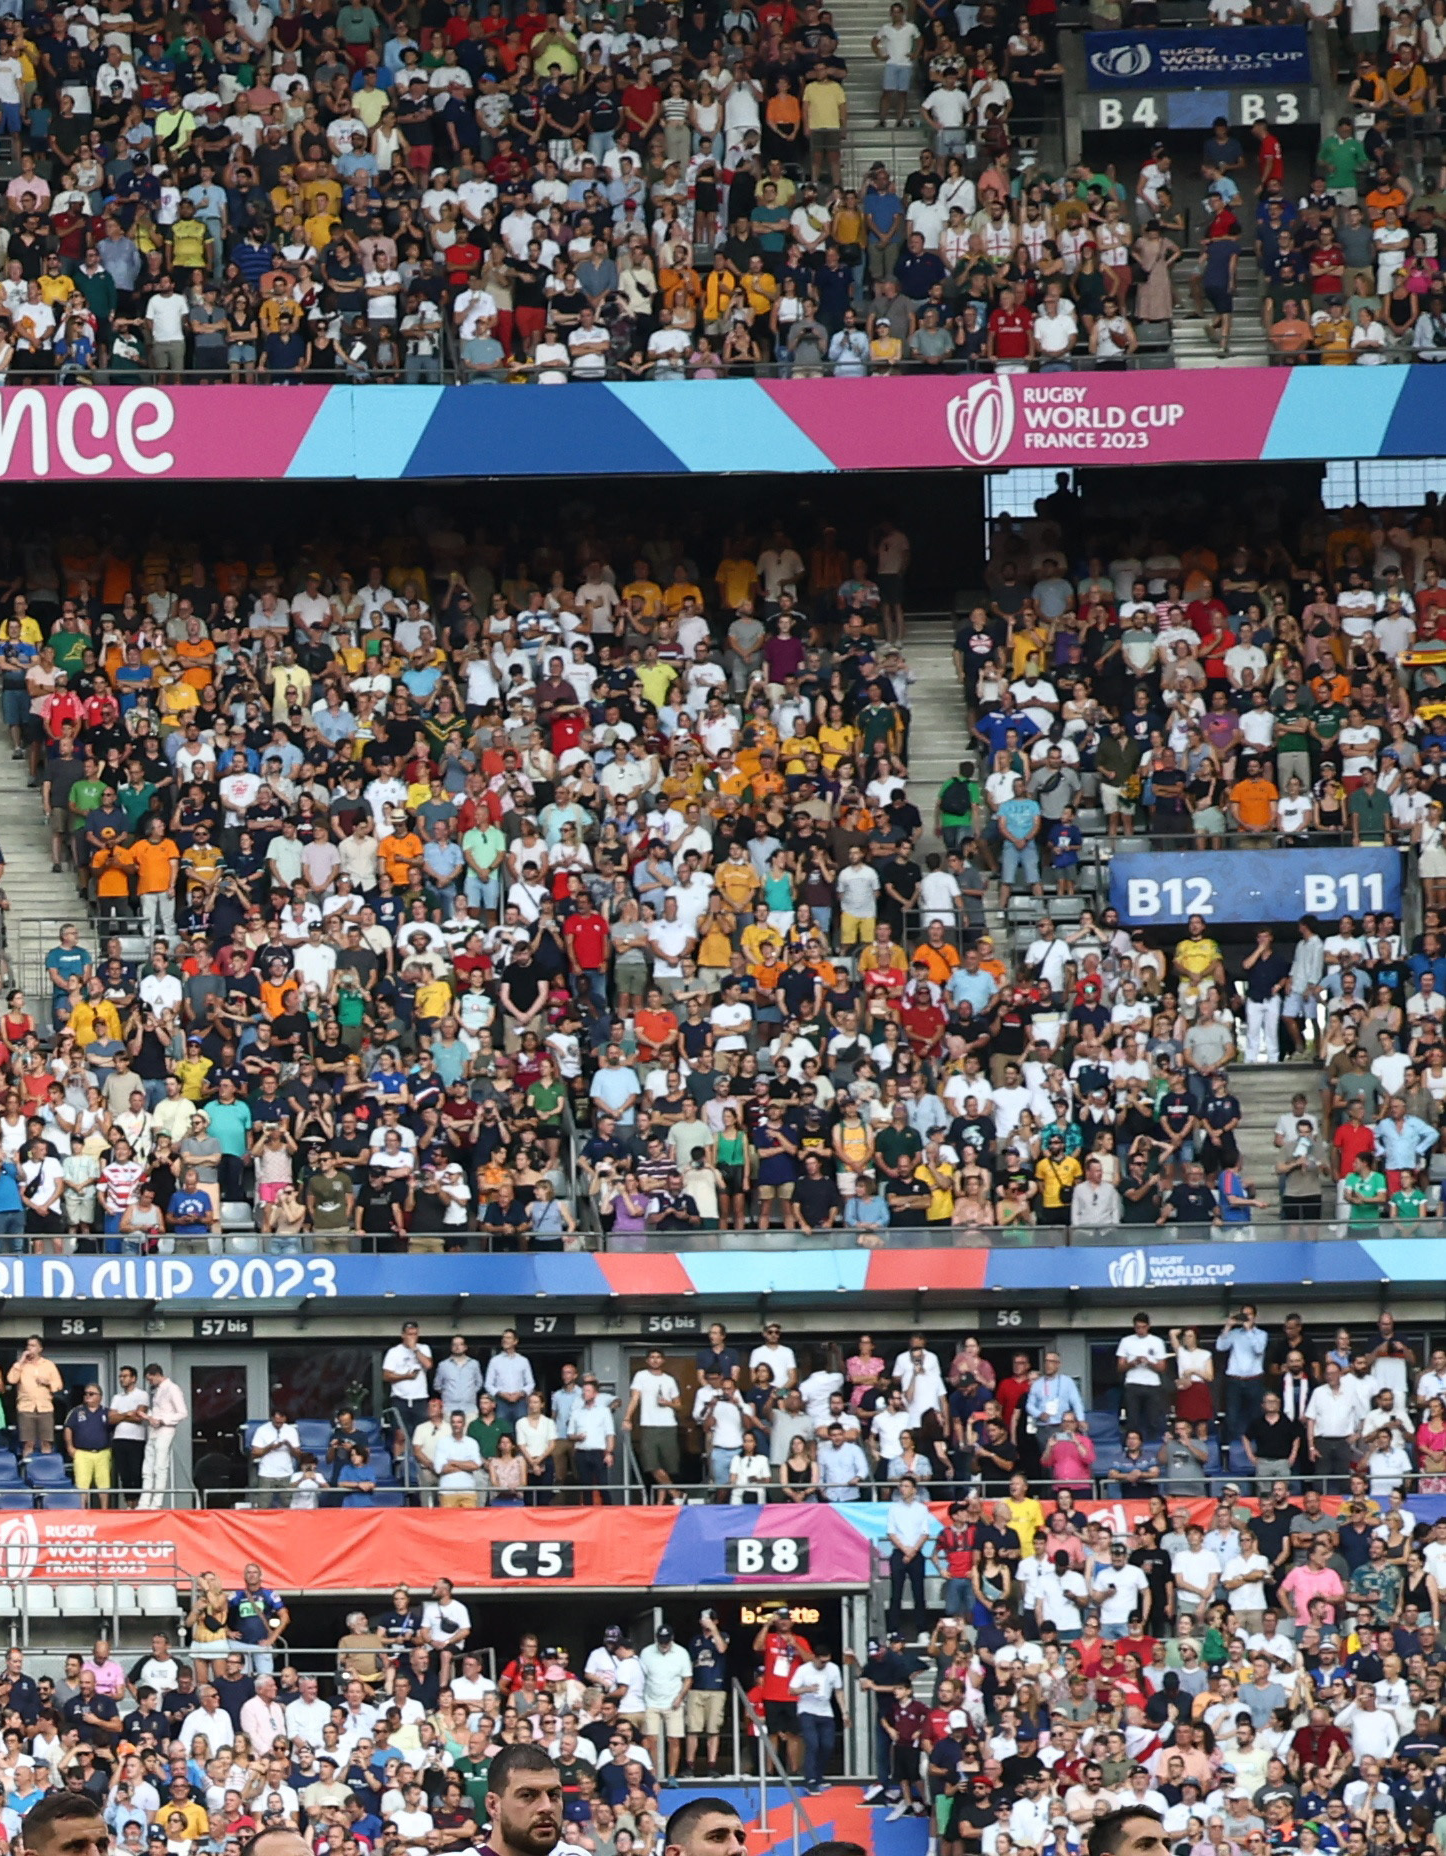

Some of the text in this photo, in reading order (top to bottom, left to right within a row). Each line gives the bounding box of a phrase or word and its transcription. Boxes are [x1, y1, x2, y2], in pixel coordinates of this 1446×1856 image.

[1160, 51, 1304, 66] WORLD CUP
[1160, 63, 1226, 73] FRANCE
[1023, 386, 1088, 406] RUGBY
[1023, 402, 1185, 430] WORLD CUP
[1023, 429, 1150, 451] FRANCE 2023
[1127, 877, 1214, 916] B12
[1303, 873, 1384, 912] B11
[1148, 1255, 1184, 1266] RUGBY
[91, 1259, 194, 1299] CUP
[211, 1258, 337, 1298] 2023
[1149, 1264, 1235, 1278] WORLD CUP
[60, 1319, 86, 1335] 58
[201, 1318, 248, 1336] 57 bis
[533, 1316, 558, 1332] 57
[648, 1315, 697, 1332] 56 bis
[996, 1310, 1022, 1327] 56
[45, 1525, 97, 1538] RUGBY
[45, 1541, 175, 1559] WORLD CUP
[45, 1560, 147, 1574] FRANCE 2023
